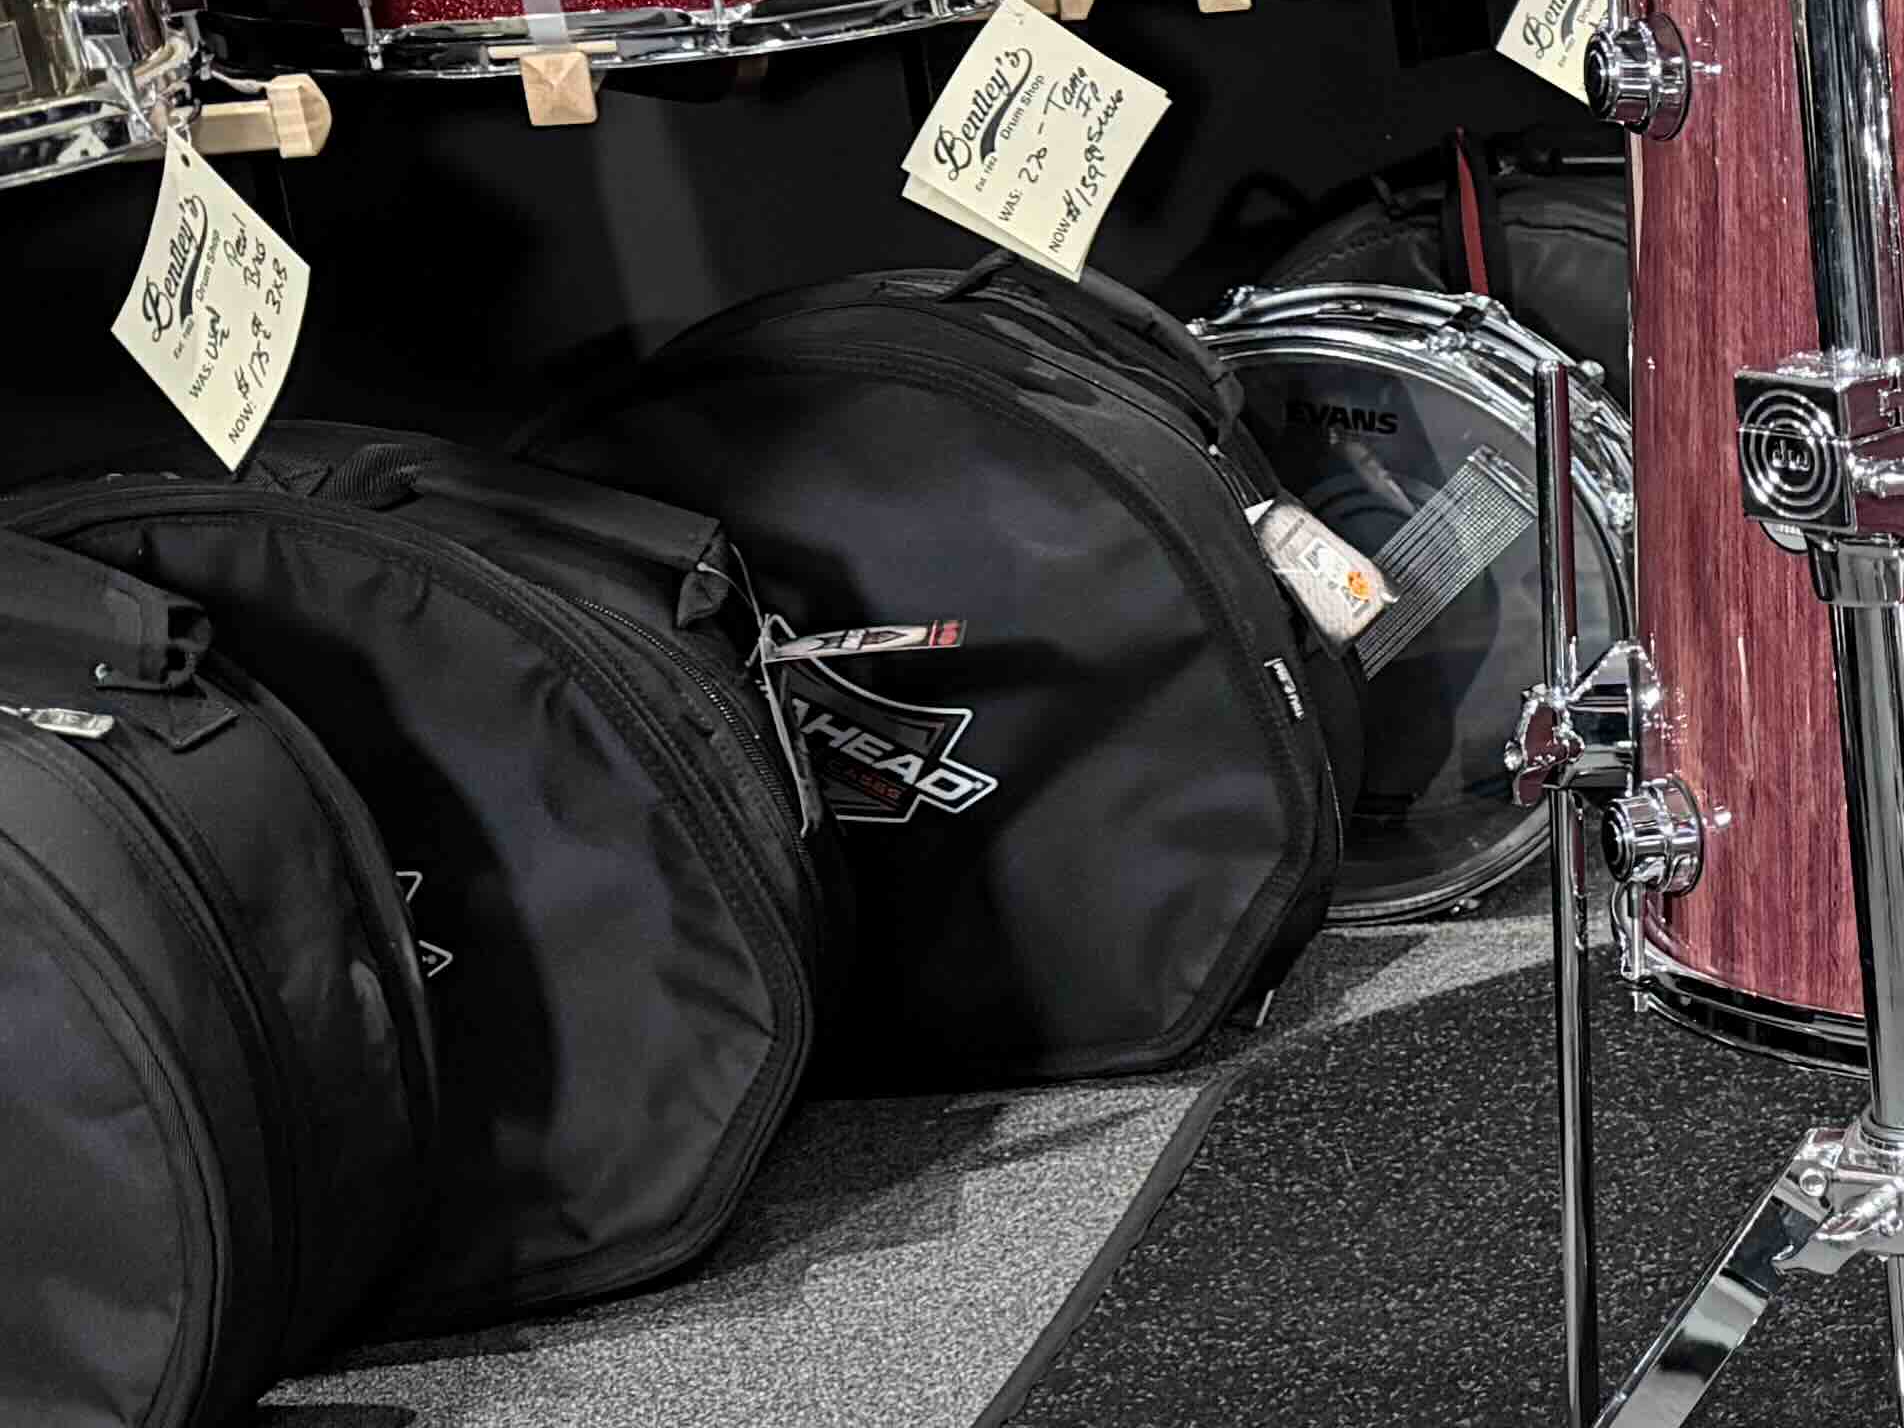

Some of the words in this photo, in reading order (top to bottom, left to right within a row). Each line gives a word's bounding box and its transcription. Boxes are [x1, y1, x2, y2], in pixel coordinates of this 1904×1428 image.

[933, 47, 1033, 182] Bentley's
[999, 105, 1026, 140] Drum
[1021, 73, 1046, 106] Shop
[997, 189, 1025, 223] WAS:
[204, 228, 222, 261] Shop
[142, 194, 208, 343] Bentley's
[195, 261, 214, 303] Drum
[189, 361, 215, 399] WAS:
[228, 403, 257, 445] NOW:
[1285, 400, 1399, 435] EVANS
[1772, 439, 1810, 472] dw
